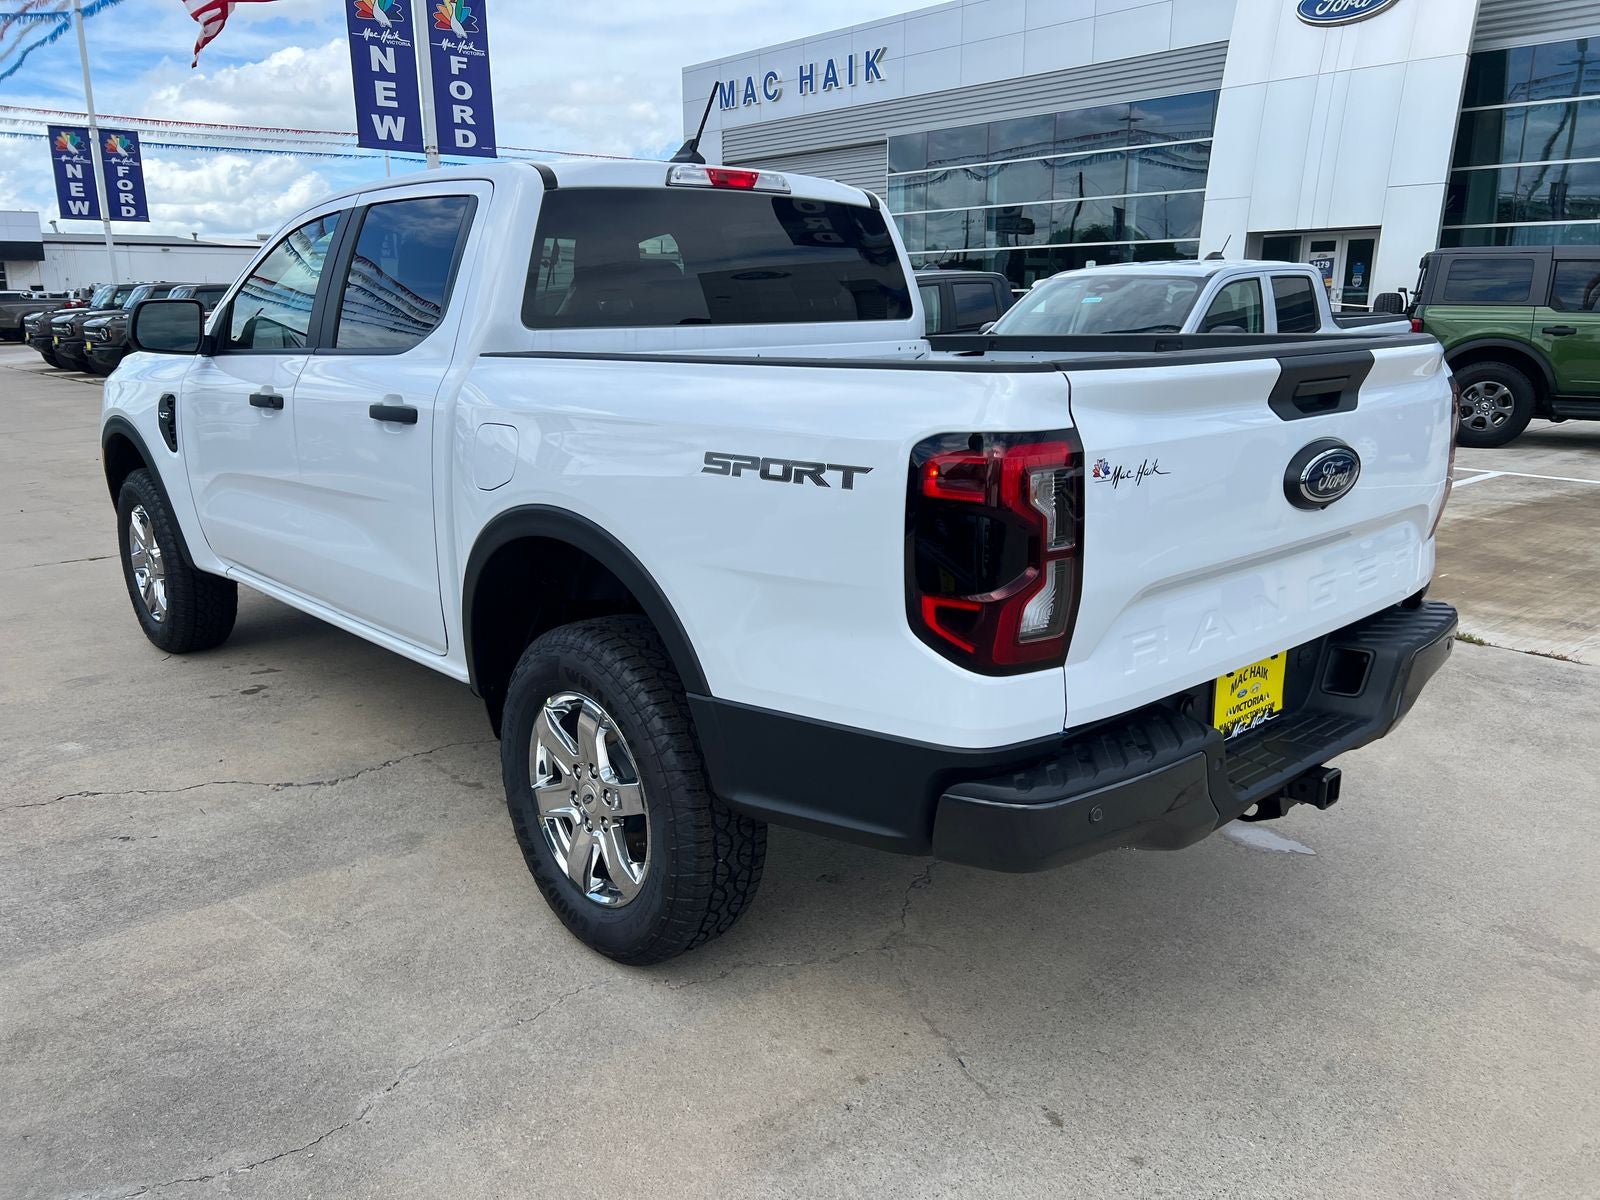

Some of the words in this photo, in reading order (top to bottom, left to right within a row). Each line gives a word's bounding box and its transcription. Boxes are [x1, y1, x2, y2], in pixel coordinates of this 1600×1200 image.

[352, 28, 380, 41] Mac
[380, 29, 411, 43] Haik
[386, 40, 412, 48] VICTORIA
[431, 38, 457, 51] Mac
[457, 40, 485, 53] Haik
[369, 45, 406, 142] NEW
[719, 71, 782, 110] MAC
[799, 47, 887, 95] HAIK
[449, 55, 477, 148] FORD
[65, 163, 90, 215] NEW
[117, 166, 136, 217] FORD
[701, 451, 874, 490] SPORT
[1095, 465, 1135, 489] Mac
[1135, 458, 1171, 486] Haik
[1318, 460, 1353, 491] Ford
[1122, 540, 1415, 676] RANGER
[1230, 669, 1248, 696] MAC
[1250, 665, 1269, 680] HAIK
[1232, 693, 1264, 715] VICTORIA
[1224, 722, 1251, 741] Mac
[1250, 709, 1279, 729] Haik
